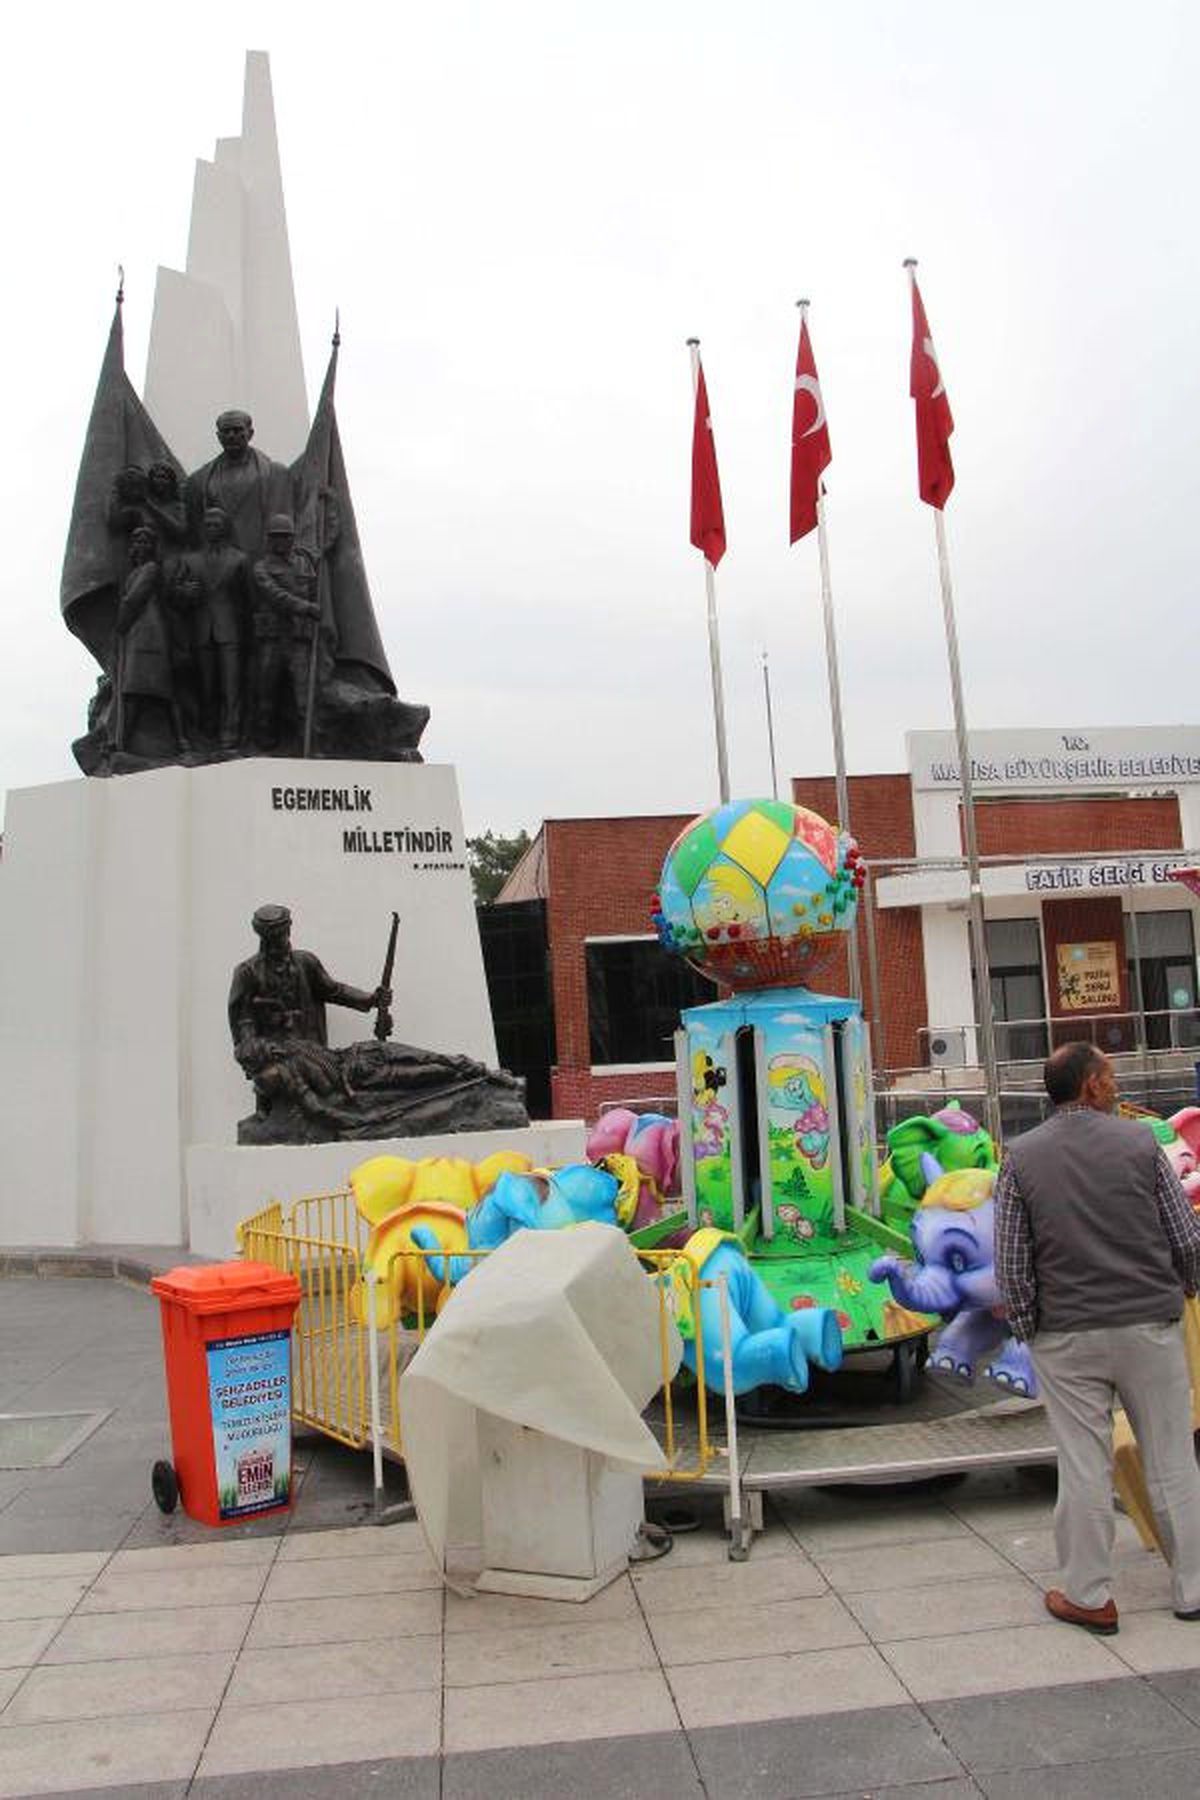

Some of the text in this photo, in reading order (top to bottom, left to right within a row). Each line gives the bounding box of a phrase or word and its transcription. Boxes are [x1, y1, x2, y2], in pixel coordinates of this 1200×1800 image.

[931, 759, 1000, 781] MAİSA
[1005, 757, 1115, 783] BÜYÜKŞEHİR
[272, 785, 372, 811] EGEMENLİK
[343, 825, 453, 853] MİLLETİNDİR
[1025, 867, 1083, 890] FATİH
[1088, 863, 1145, 886] SERGİ
[238, 1461, 273, 1484] EMİN
